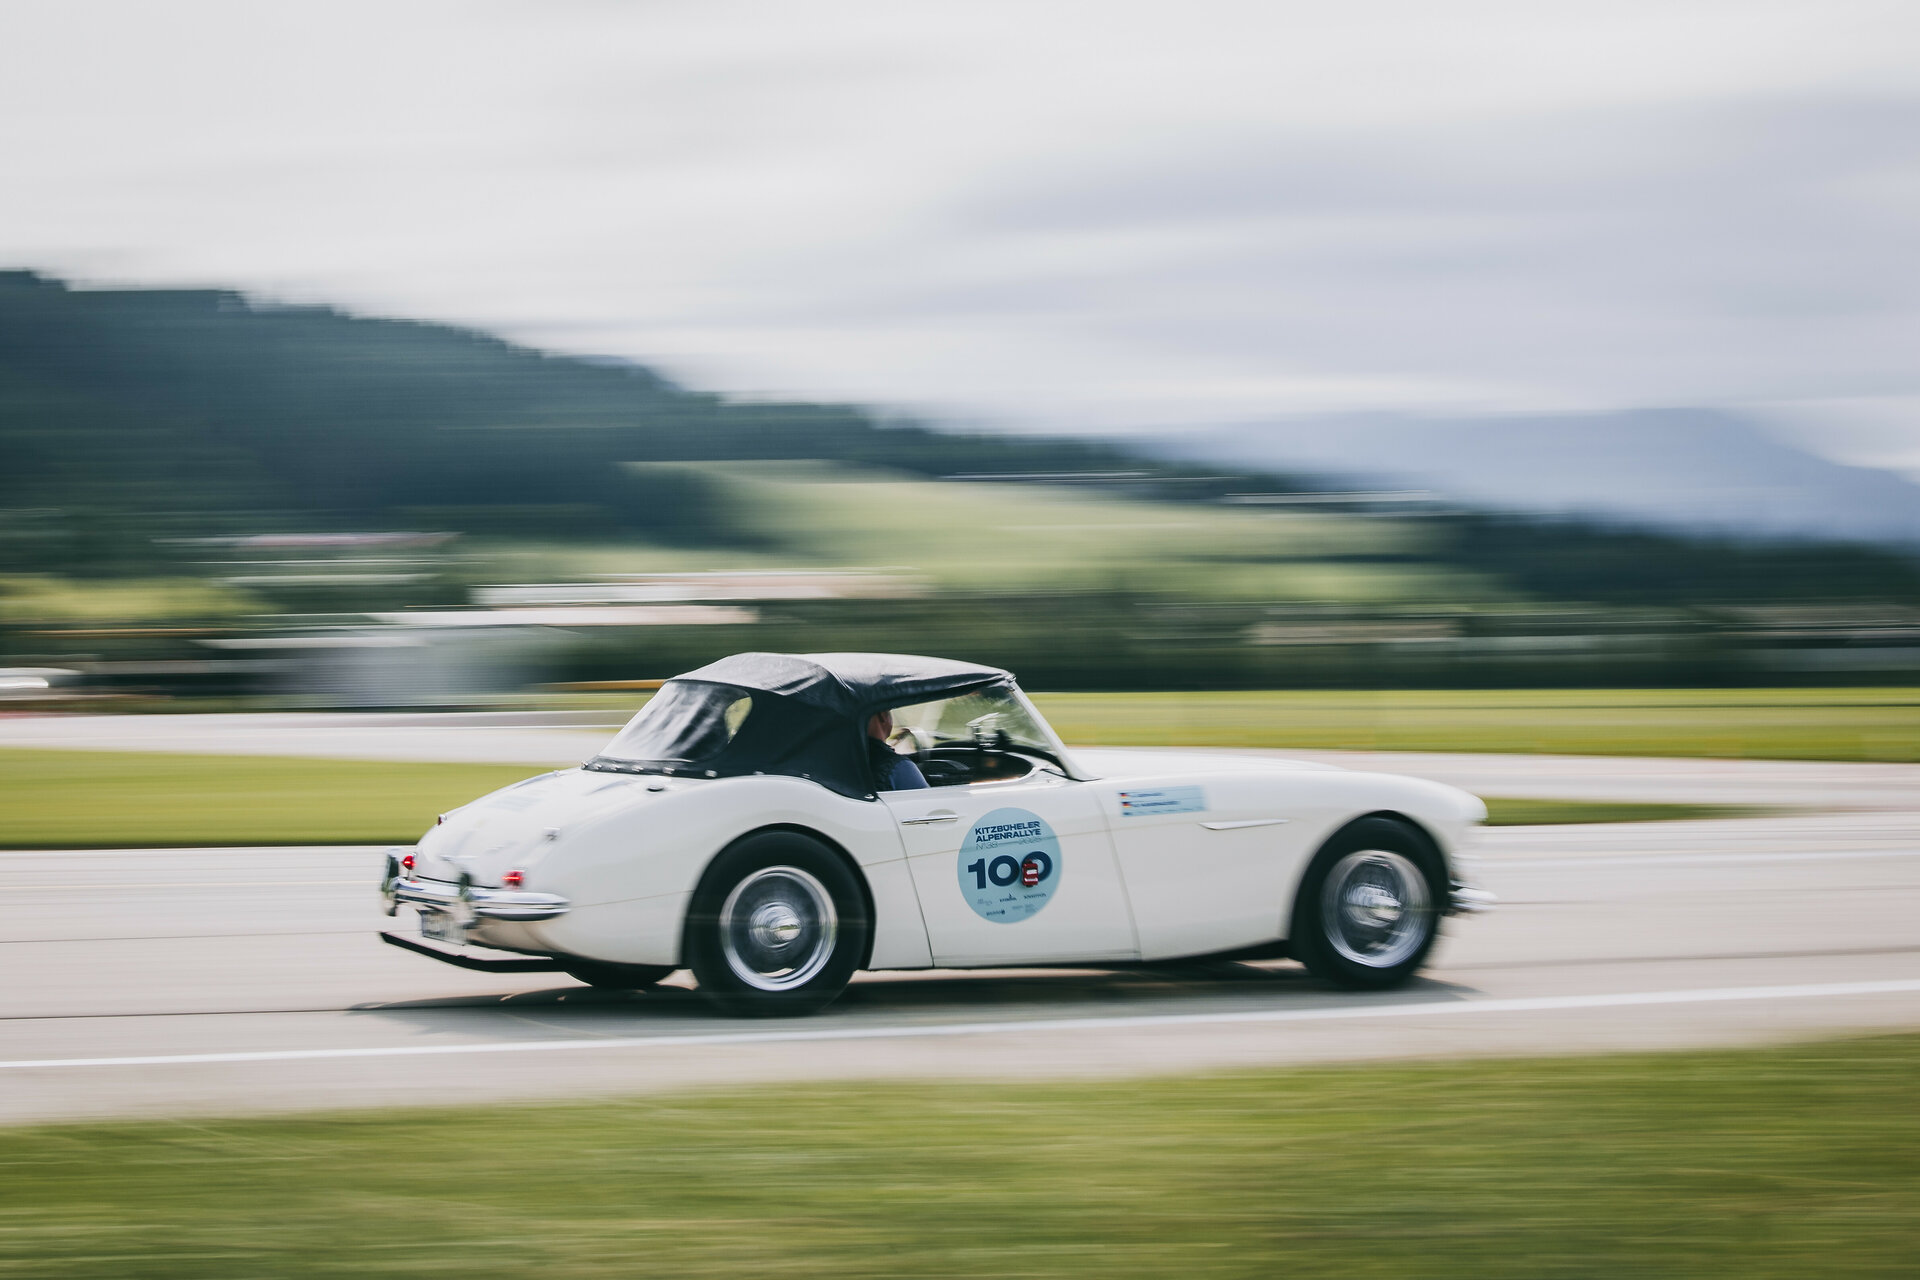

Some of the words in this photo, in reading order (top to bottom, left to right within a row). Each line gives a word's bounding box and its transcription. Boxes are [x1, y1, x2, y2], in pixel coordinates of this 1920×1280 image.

[975, 821, 1041, 835] KITZBÜHELER
[975, 829, 1042, 843] ALPENRALLYE
[968, 851, 1053, 890] 100
